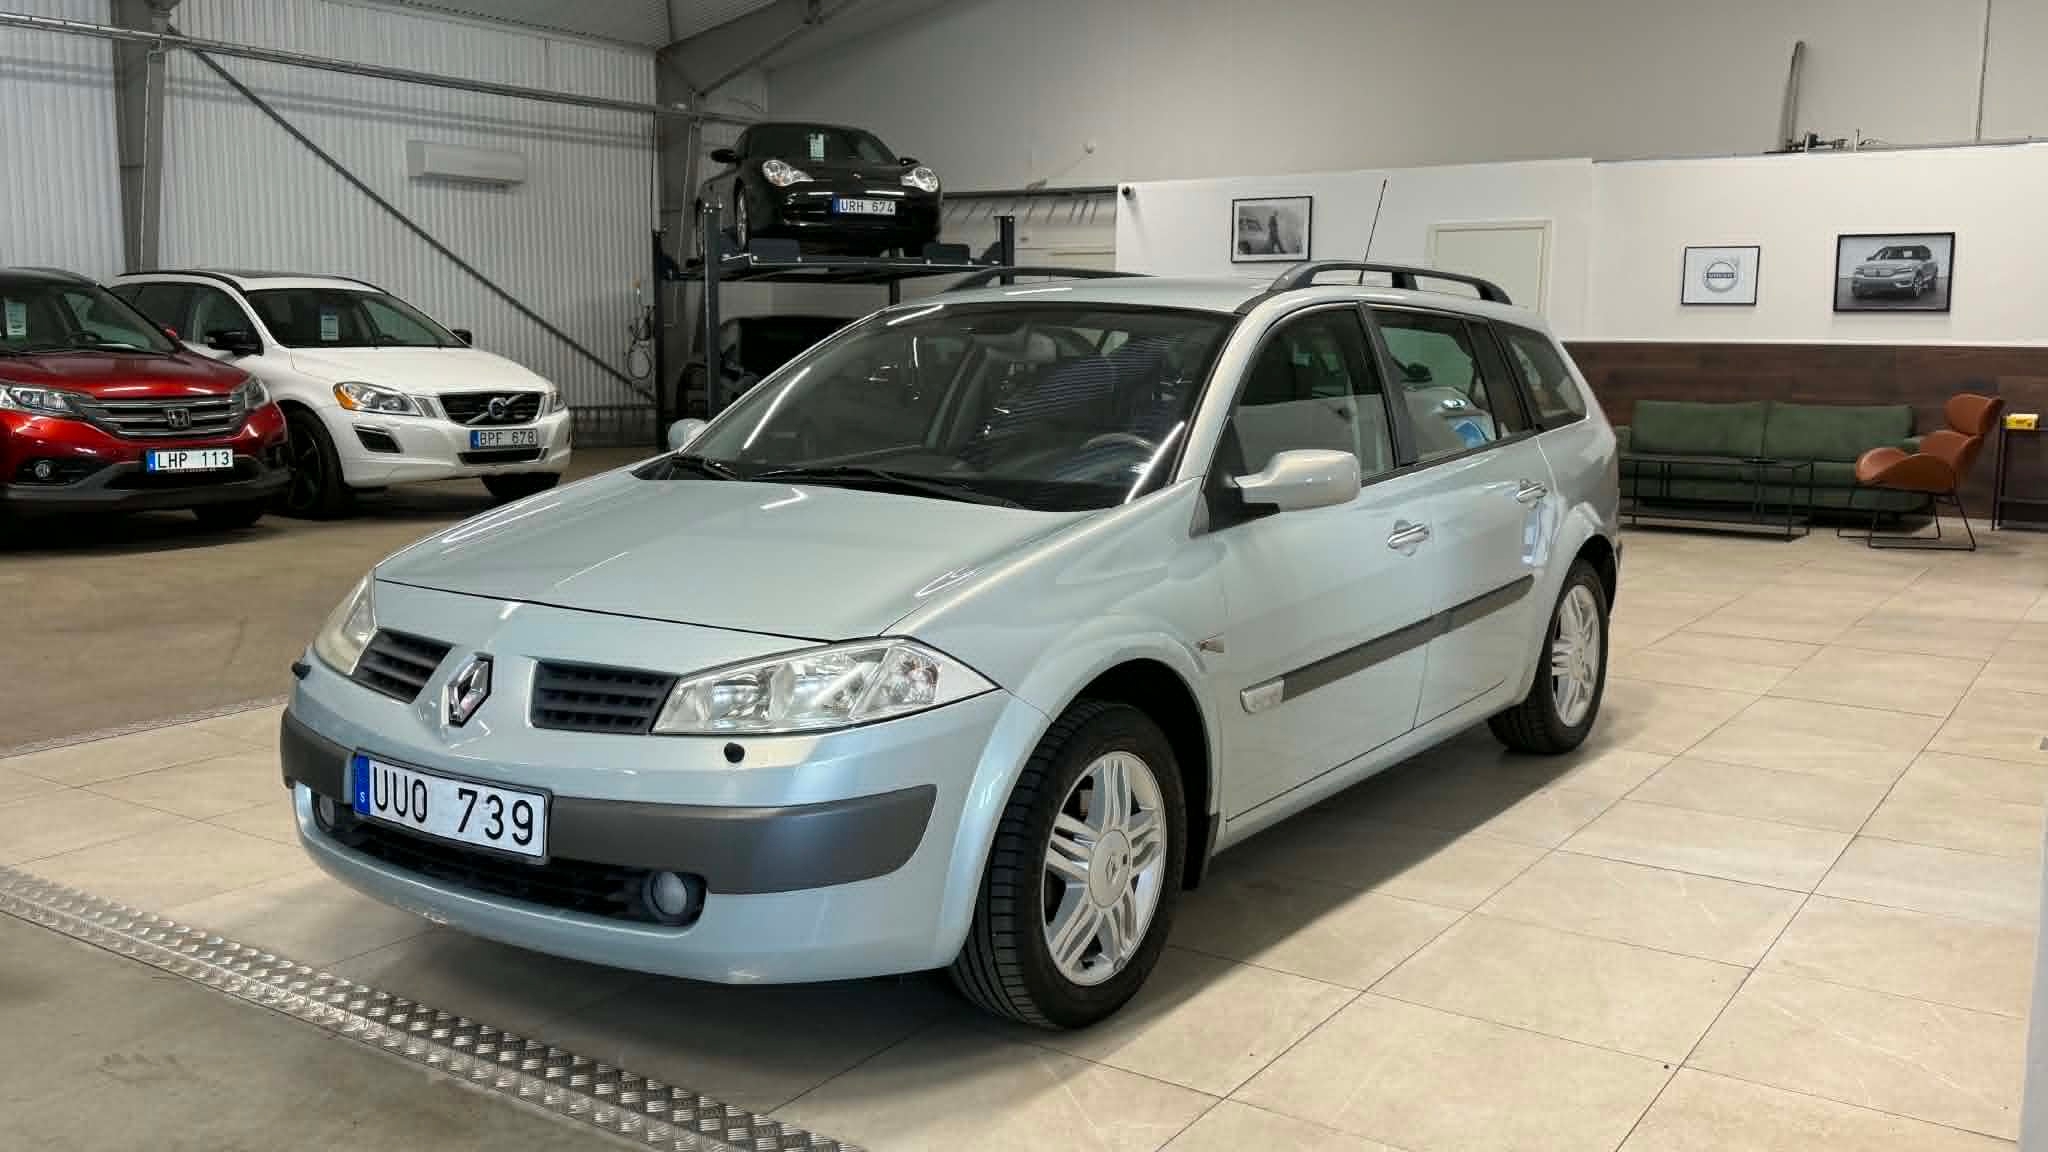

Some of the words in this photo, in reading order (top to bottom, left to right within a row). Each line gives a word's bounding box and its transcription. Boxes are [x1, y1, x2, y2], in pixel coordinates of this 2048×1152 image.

[841, 200, 863, 211] URH
[480, 432, 503, 445] BPF
[512, 431, 534, 444] 678
[158, 452, 188, 468] LHP
[201, 451, 229, 466] 113
[360, 792, 366, 803] S
[374, 767, 427, 823] UUO
[457, 788, 533, 846] 739
